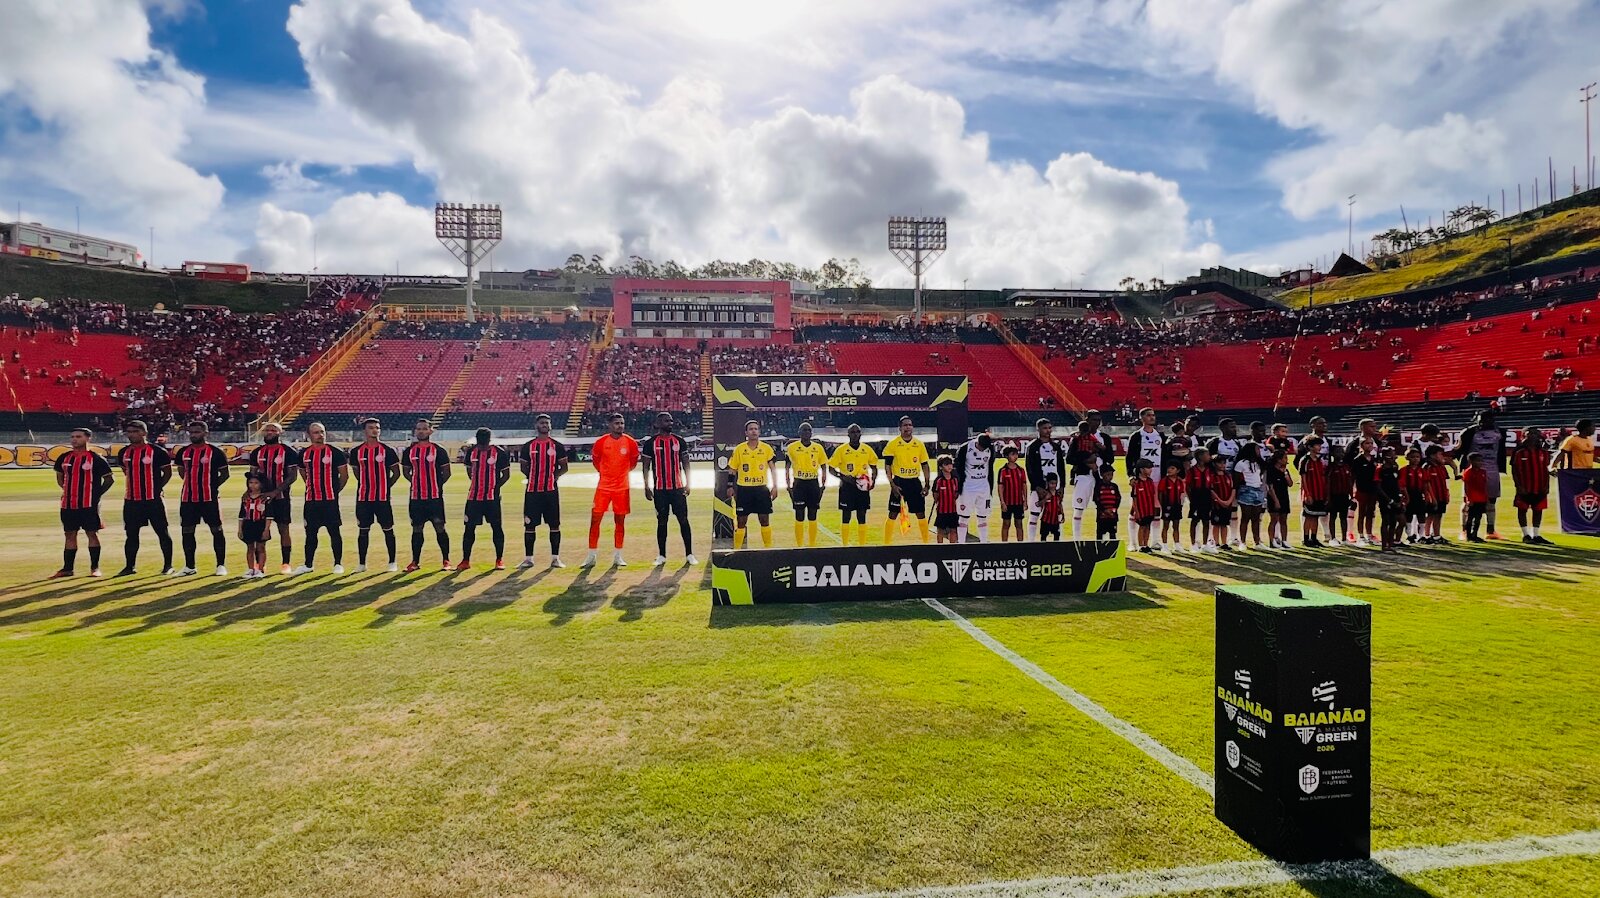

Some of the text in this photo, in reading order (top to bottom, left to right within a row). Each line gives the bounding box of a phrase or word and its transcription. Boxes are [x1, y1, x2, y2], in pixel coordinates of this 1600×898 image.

[770, 378, 867, 397] BAIANÃO
[889, 386, 928, 395] GREEN
[827, 396, 857, 406] 2026
[1143, 448, 1159, 457] 7K
[984, 558, 1028, 568] MANSÃO
[1030, 563, 1073, 577] 2026
[796, 558, 938, 588] BAIANÃO
[971, 567, 1028, 581] GREEN
[1217, 686, 1273, 724] BAIANÃO
[1283, 707, 1366, 727] BAIANÃO
[1236, 715, 1266, 739] GREEN
[1315, 731, 1357, 743] GREEN
